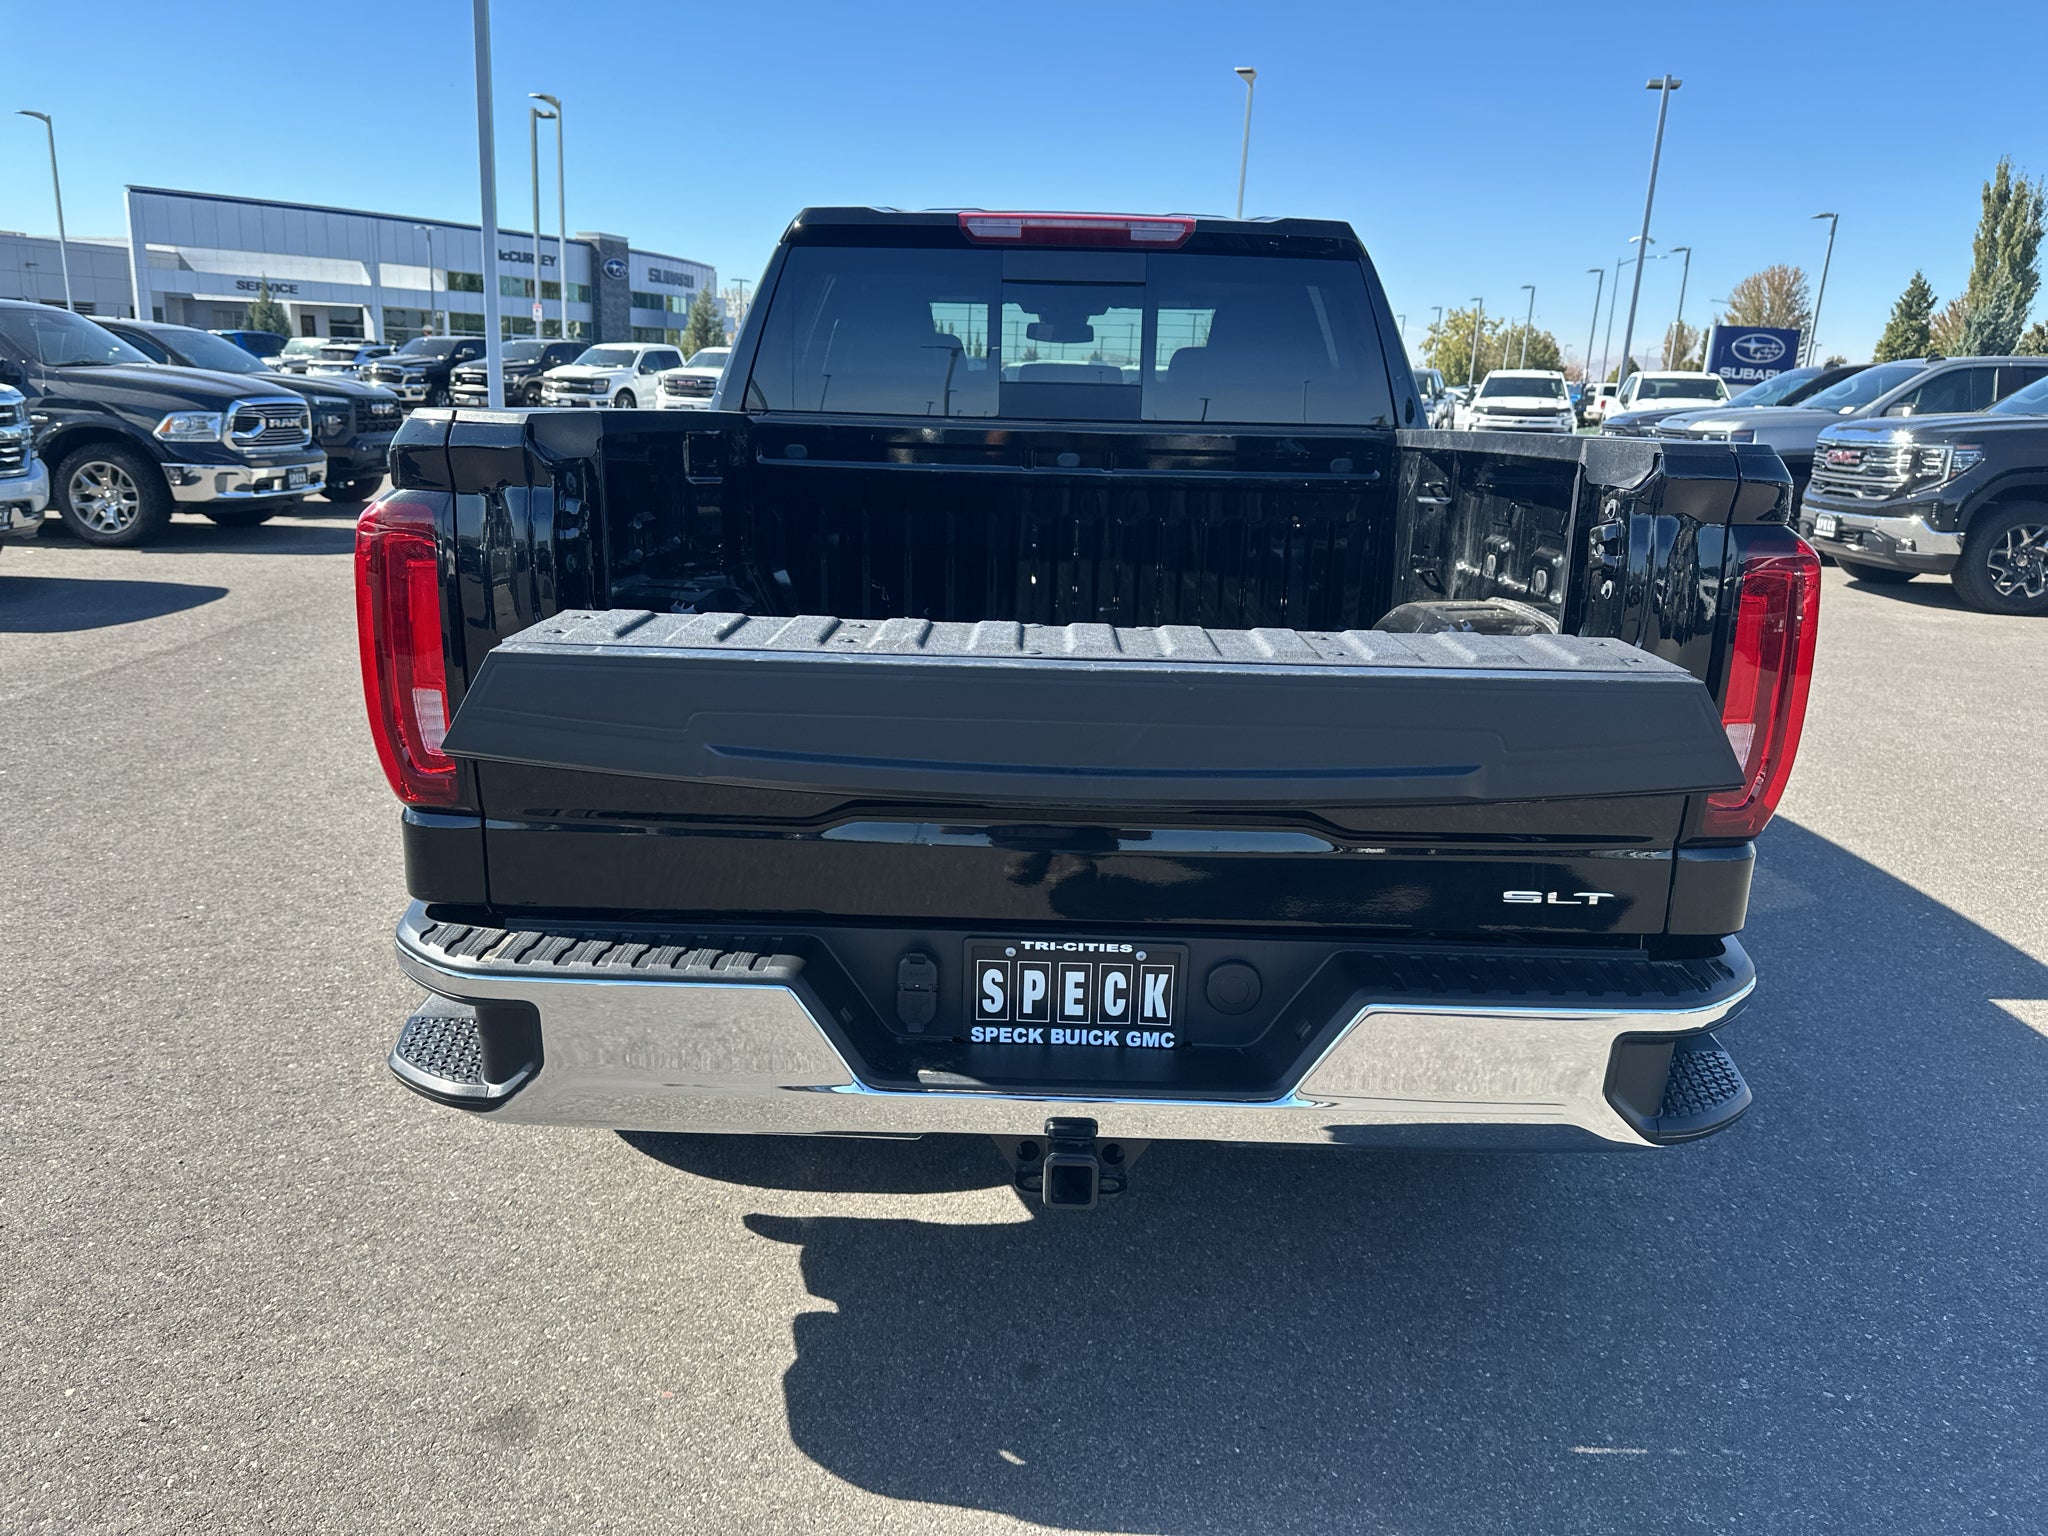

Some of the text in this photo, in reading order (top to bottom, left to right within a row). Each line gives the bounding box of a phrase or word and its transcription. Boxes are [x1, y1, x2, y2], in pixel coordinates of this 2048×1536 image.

[498, 249, 557, 267] cCUREY
[1719, 366, 1781, 381] SUBAR
[1502, 890, 1615, 905] SLT
[1020, 940, 1134, 953] TRI-CITIES
[981, 968, 1170, 1018] SPECK
[970, 1026, 1176, 1048] SPECK BUICK GMC
